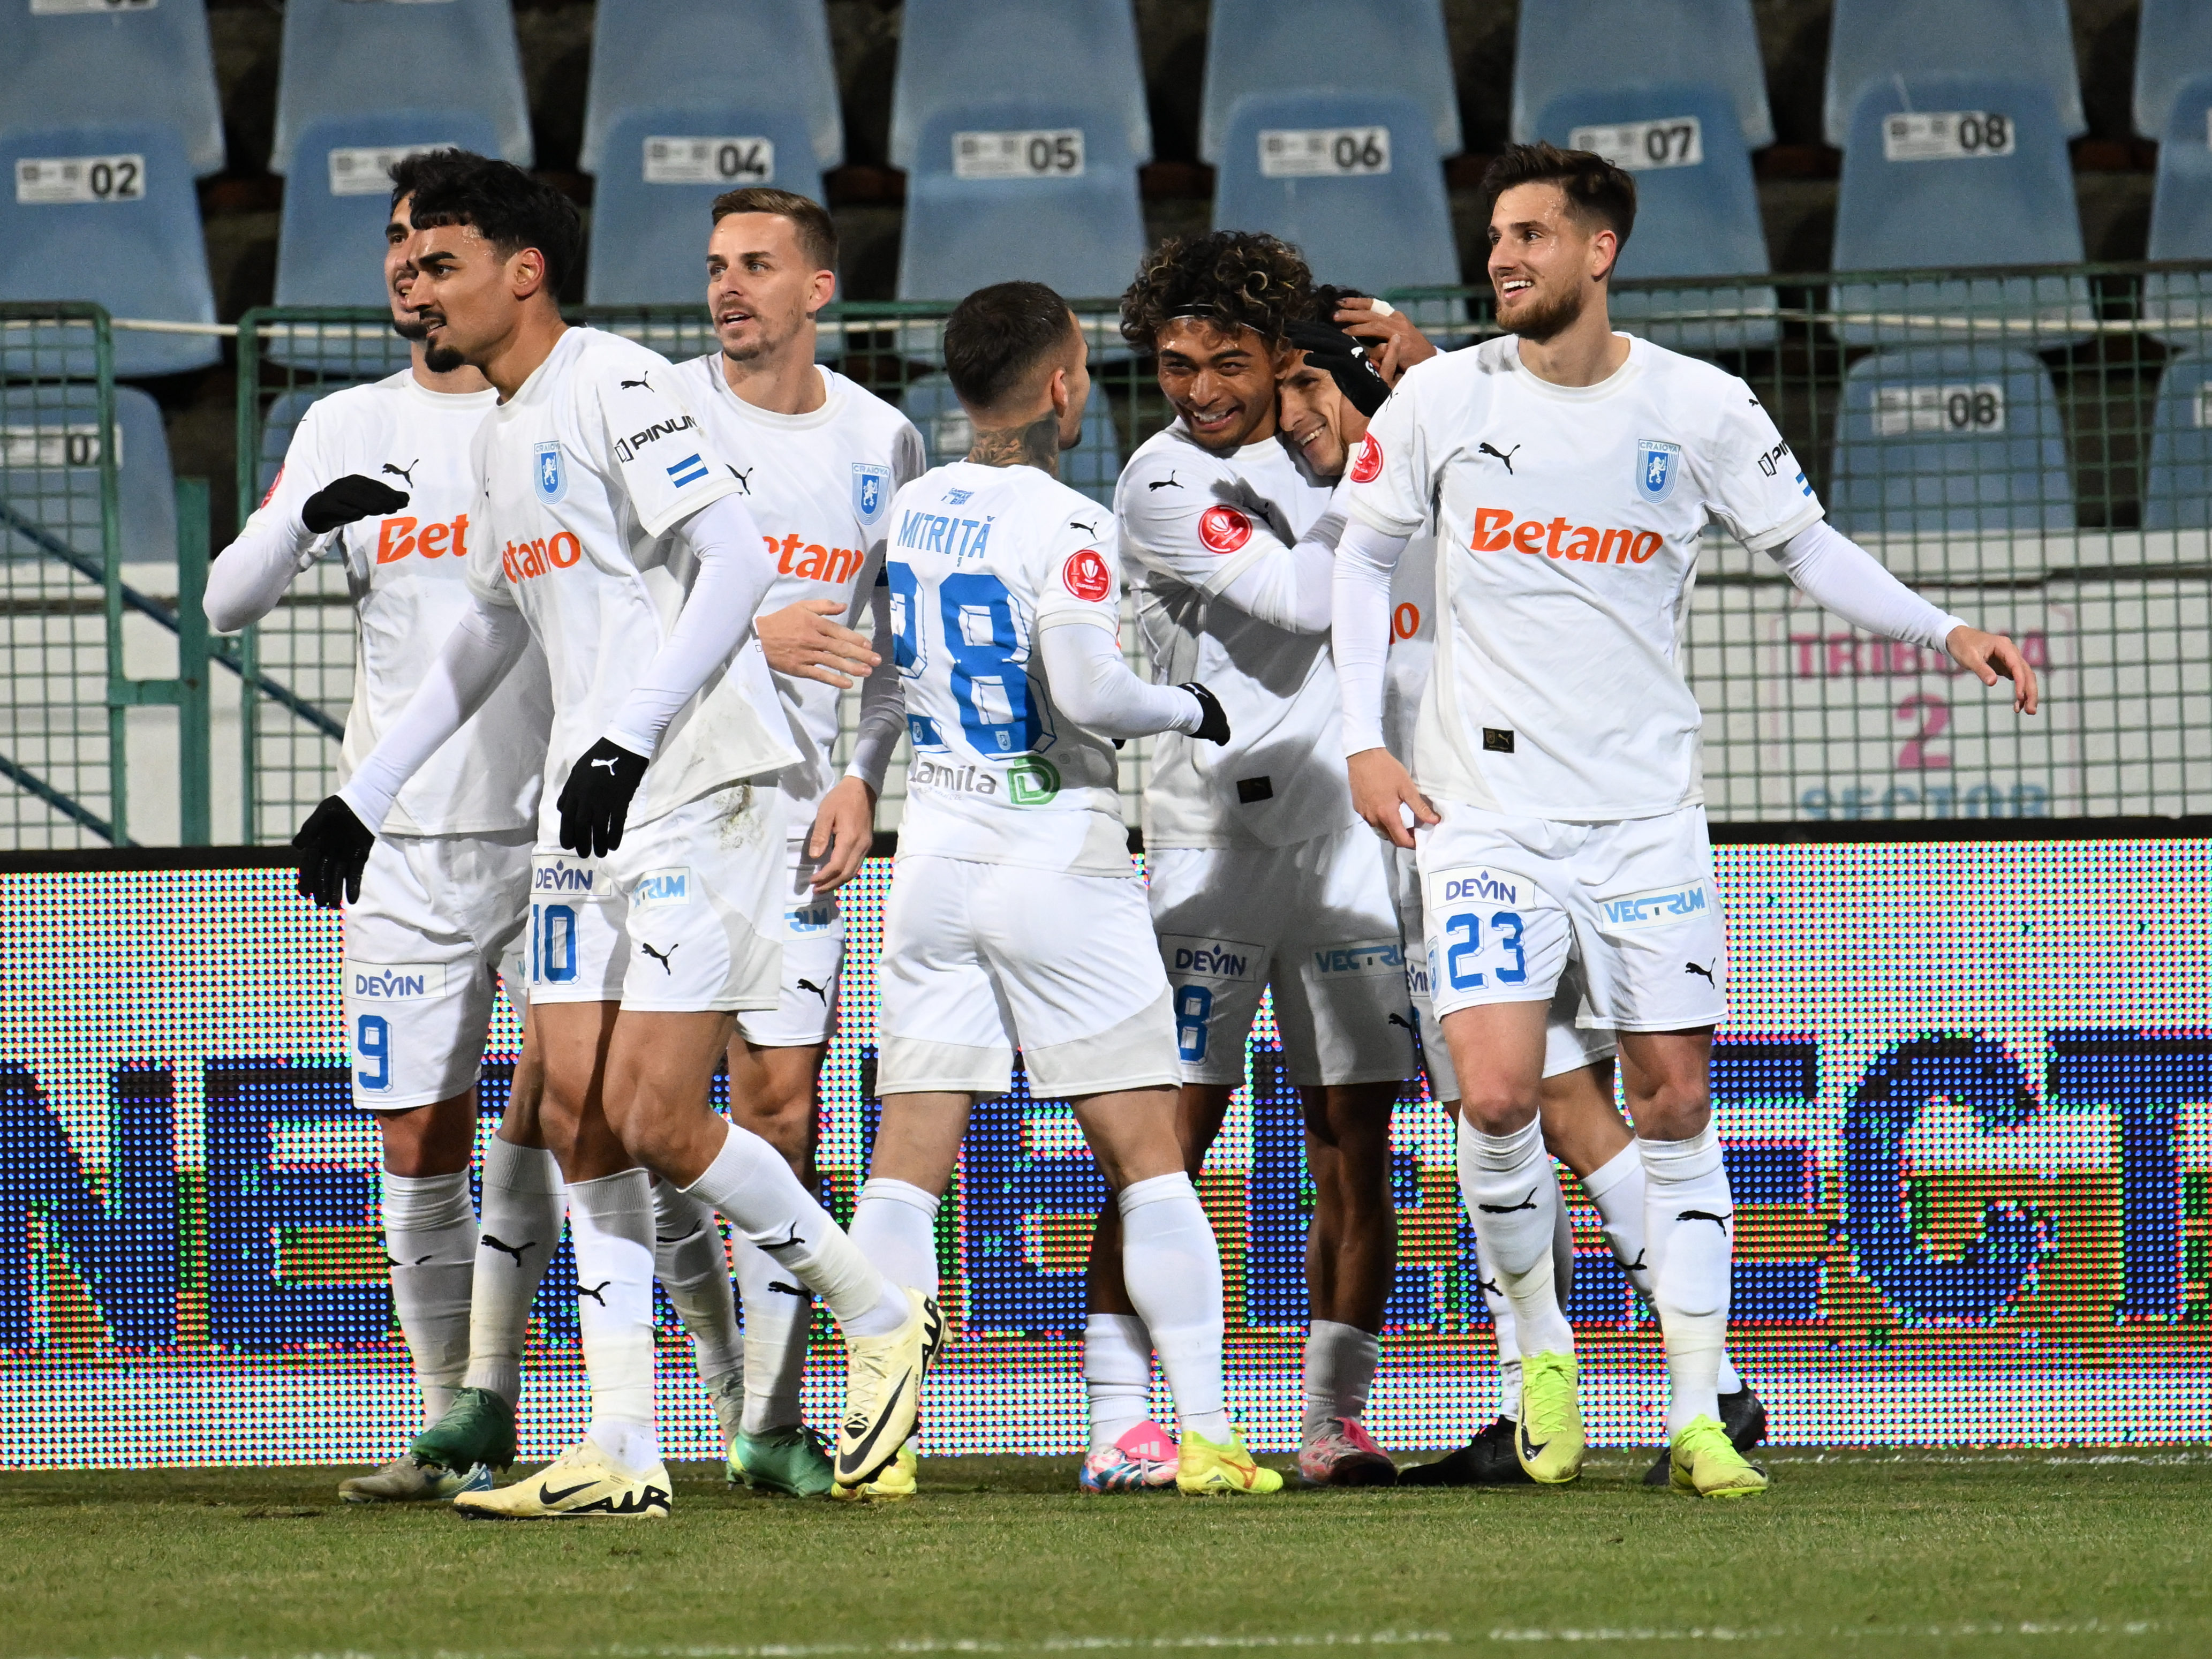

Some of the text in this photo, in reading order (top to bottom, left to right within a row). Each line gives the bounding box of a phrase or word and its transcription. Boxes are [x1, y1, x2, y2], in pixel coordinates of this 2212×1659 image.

[1646, 124, 1692, 162] 07
[1959, 114, 2008, 152] 08
[719, 144, 765, 176] 04
[1029, 138, 1077, 170] 05
[1334, 135, 1382, 169] 06
[90, 162, 138, 199] 02
[1947, 391, 1997, 427] 08
[1640, 441, 1677, 453] CRAIOVA
[854, 465, 888, 476] CRAIOVA
[897, 509, 995, 567] MITRIȚĂ
[1470, 508, 1663, 564] Betano
[887, 560, 1057, 761] 28
[1896, 692, 1951, 769] 2
[536, 867, 593, 891] DEVIN
[1446, 878, 1516, 904] DEVIN
[1604, 887, 1706, 924] VECTRUM
[533, 904, 580, 985] 10
[1175, 947, 1247, 977] DEVIN
[1315, 944, 1404, 972] VECTRU
[1446, 912, 1531, 993] 23
[356, 973, 425, 998] DEVIN
[358, 1014, 394, 1094] 9
[568, 1485, 672, 1513] AIR
